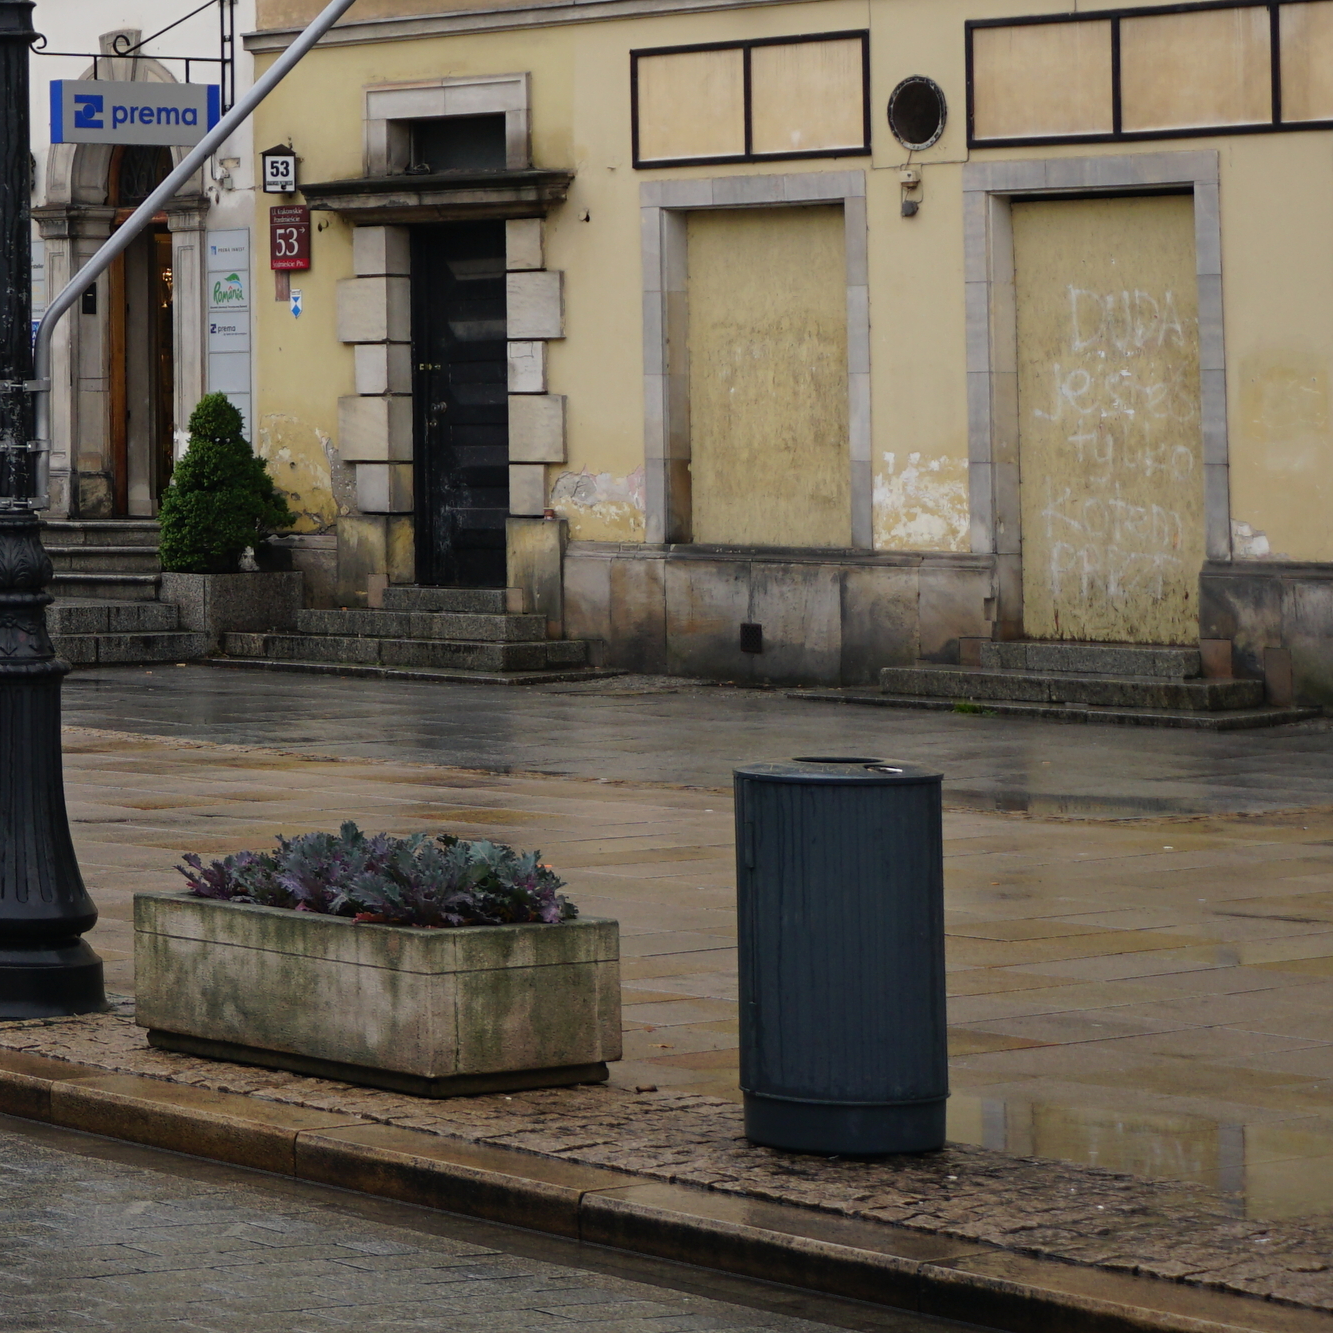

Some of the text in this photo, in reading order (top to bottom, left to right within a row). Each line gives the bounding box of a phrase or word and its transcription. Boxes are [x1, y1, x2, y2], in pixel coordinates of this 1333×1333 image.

[112, 104, 197, 129] prema
[270, 160, 290, 178] 53
[276, 227, 299, 256] 53
[1066, 284, 1184, 351] DUDA
